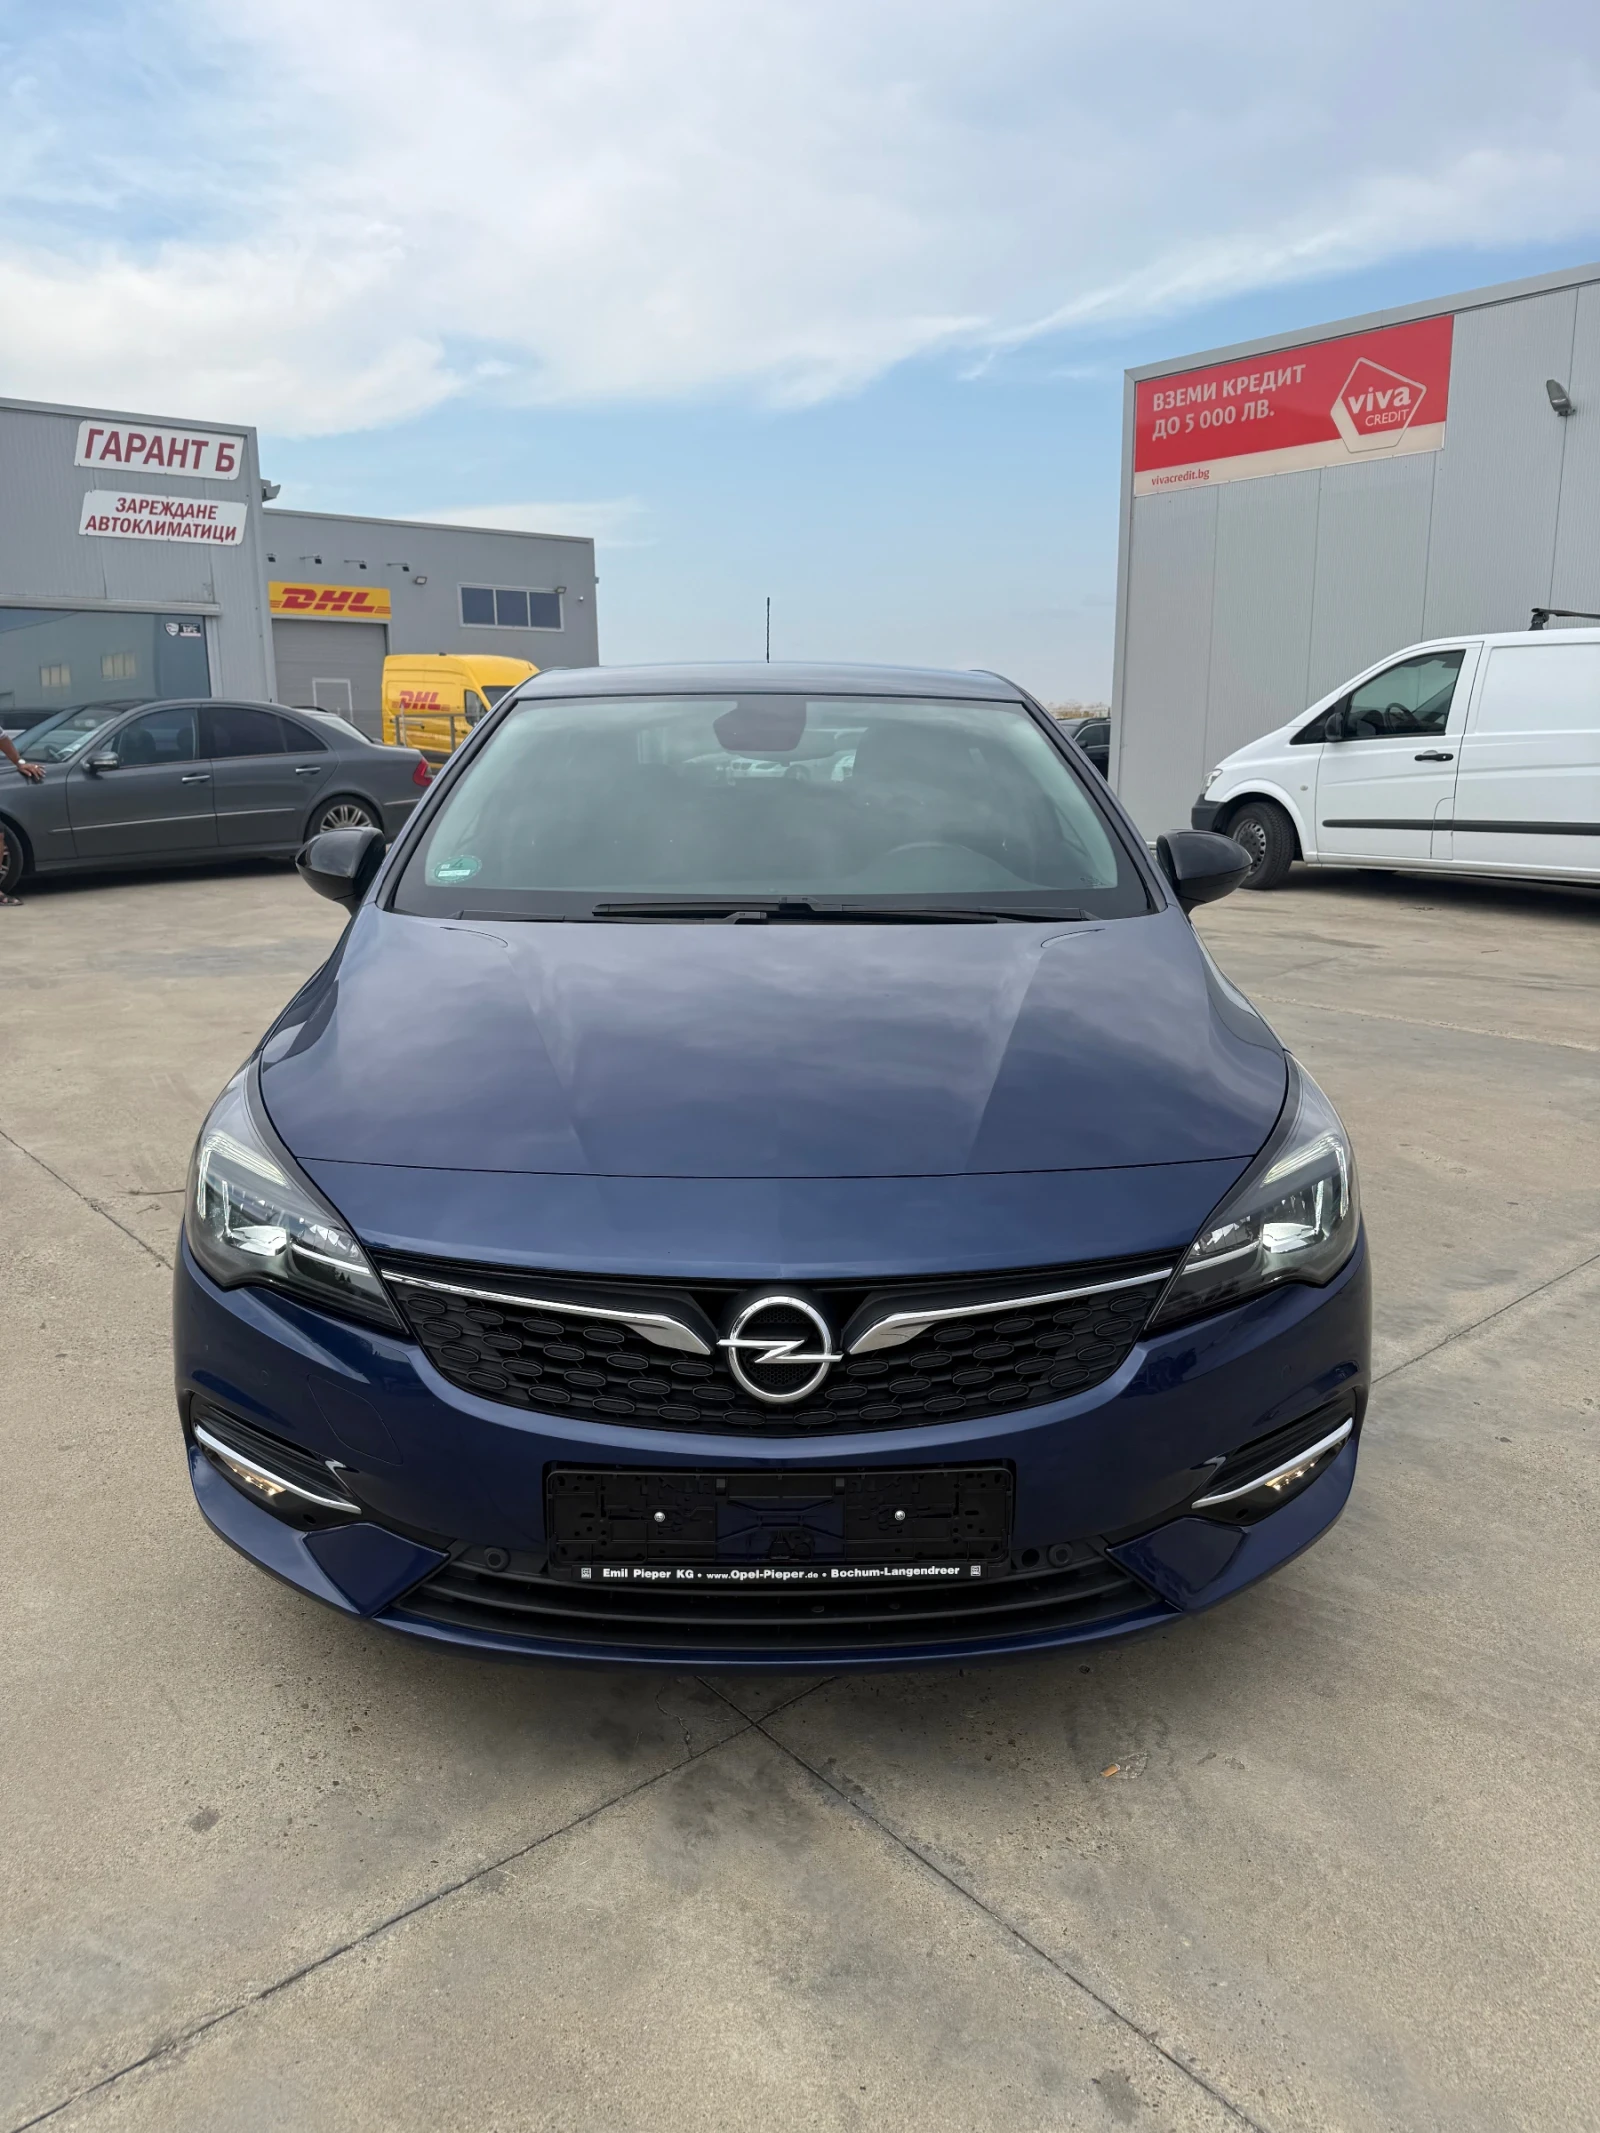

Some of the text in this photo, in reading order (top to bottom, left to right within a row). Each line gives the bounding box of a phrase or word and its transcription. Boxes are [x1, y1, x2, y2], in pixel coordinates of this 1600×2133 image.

[1153, 364, 1306, 411] ВЗЕМИ КРЕДИТ
[1348, 386, 1411, 415] viva
[1152, 400, 1275, 441] ДО 5 000 ЛВ.
[1365, 409, 1409, 427] CREDIT
[84, 428, 235, 473] ГАРАНТ Б
[1151, 468, 1210, 486] vivacredit.bg
[115, 497, 219, 521] ЗАРЕЖДАНЕ
[84, 515, 237, 543] АВТОКЛИМАТИЦИ
[281, 587, 375, 613] DHL
[399, 690, 441, 710] DHL
[603, 1565, 960, 1581] Emil Pieper KG www.Opel-Pieper.de Bochum-Langendreer
